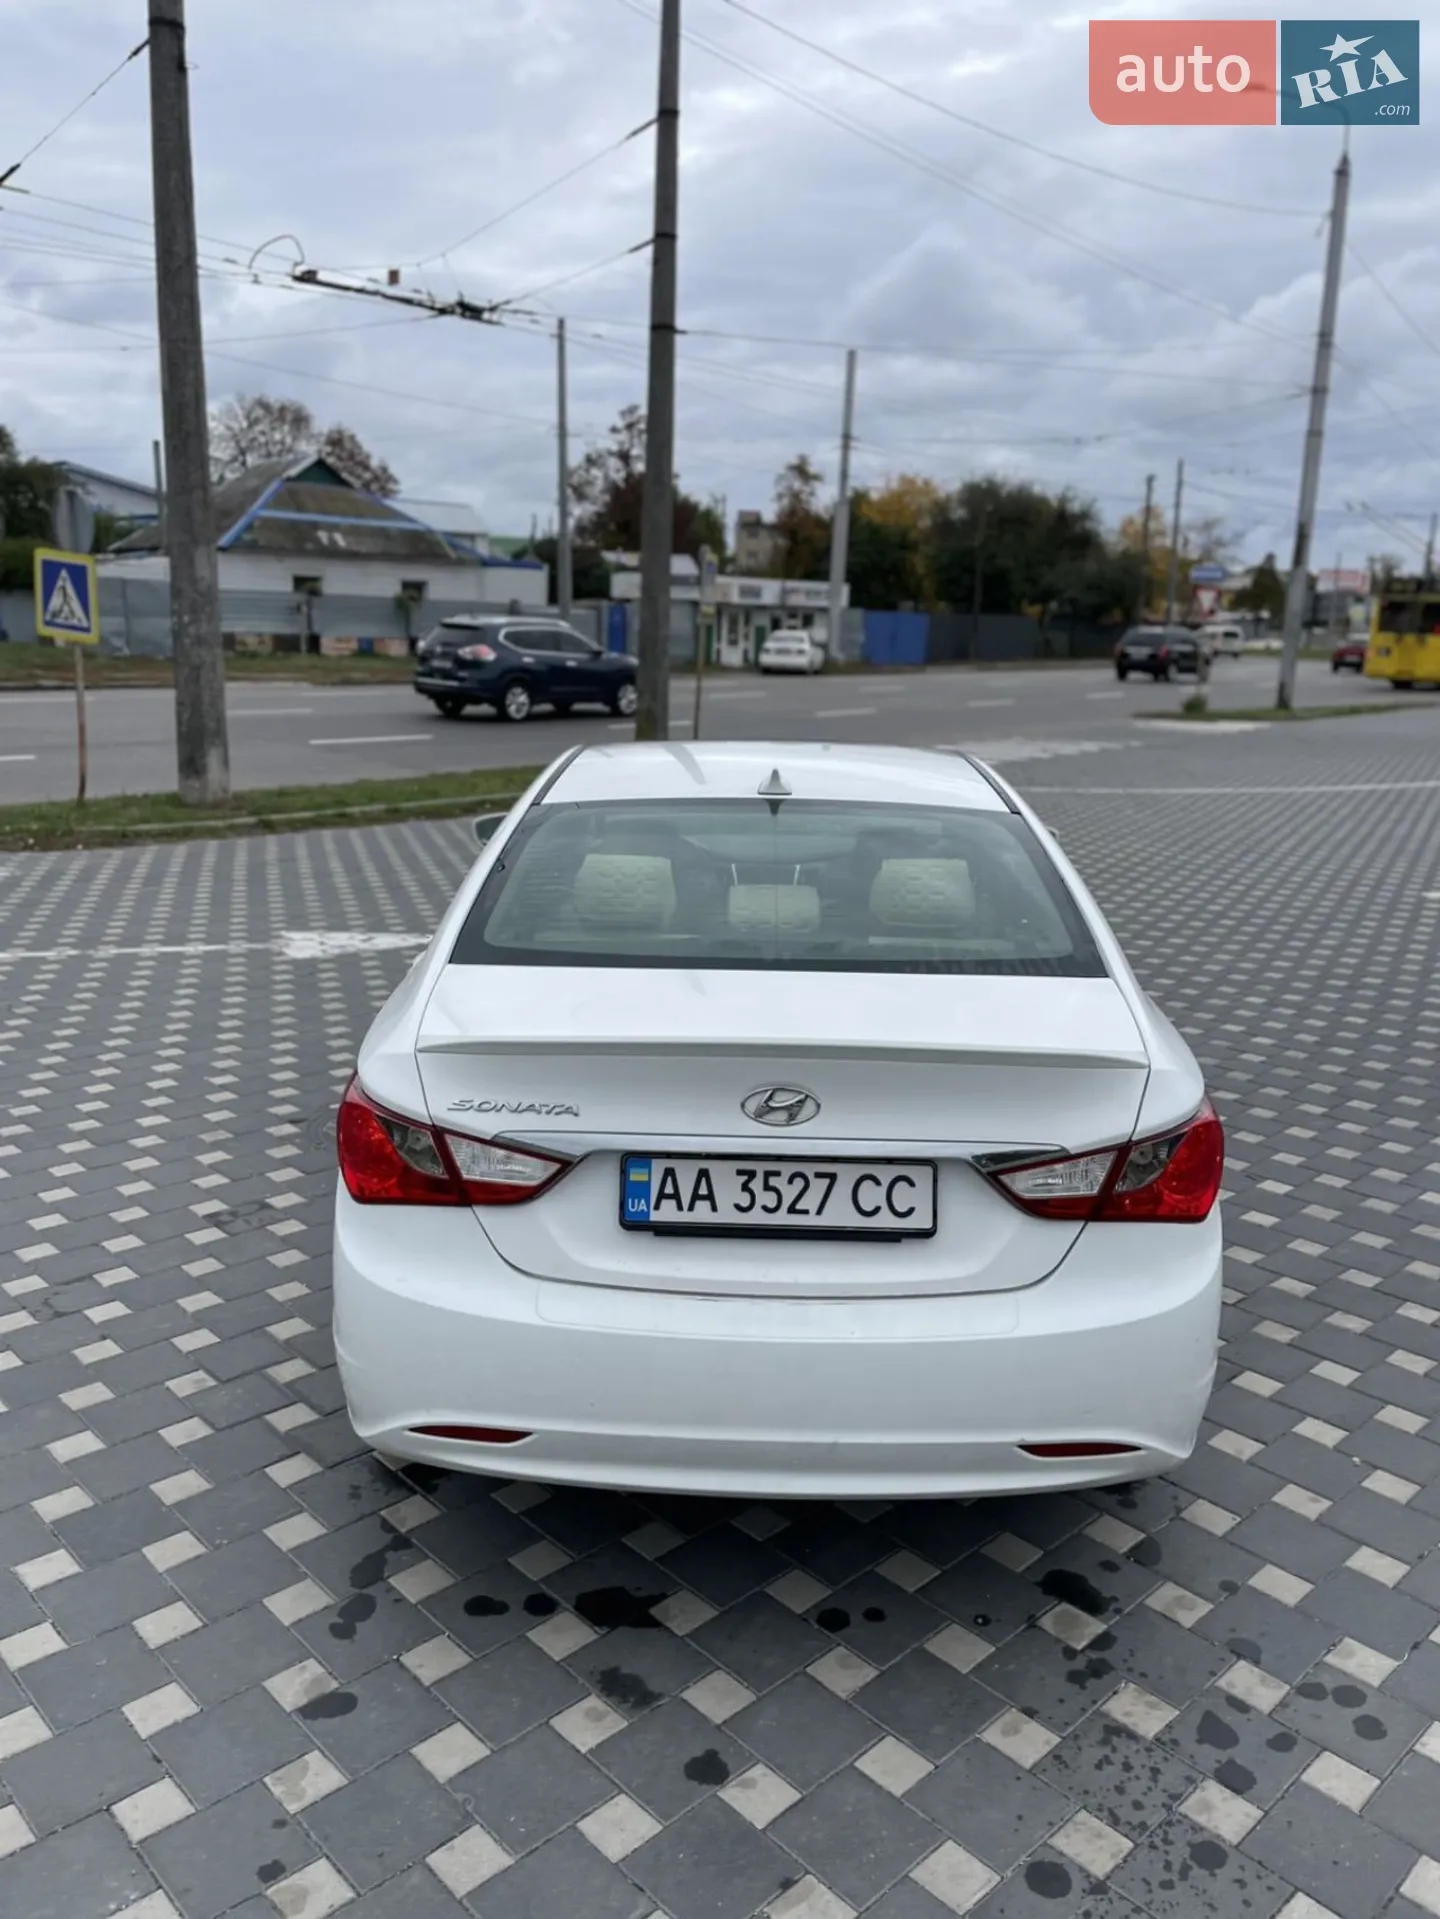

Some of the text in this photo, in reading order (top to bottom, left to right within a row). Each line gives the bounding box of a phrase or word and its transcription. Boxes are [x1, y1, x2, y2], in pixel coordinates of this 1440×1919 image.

[446, 1098, 581, 1118] SONATA
[653, 1167, 917, 1218] AA 3527 CC
[628, 1197, 648, 1213] UA
